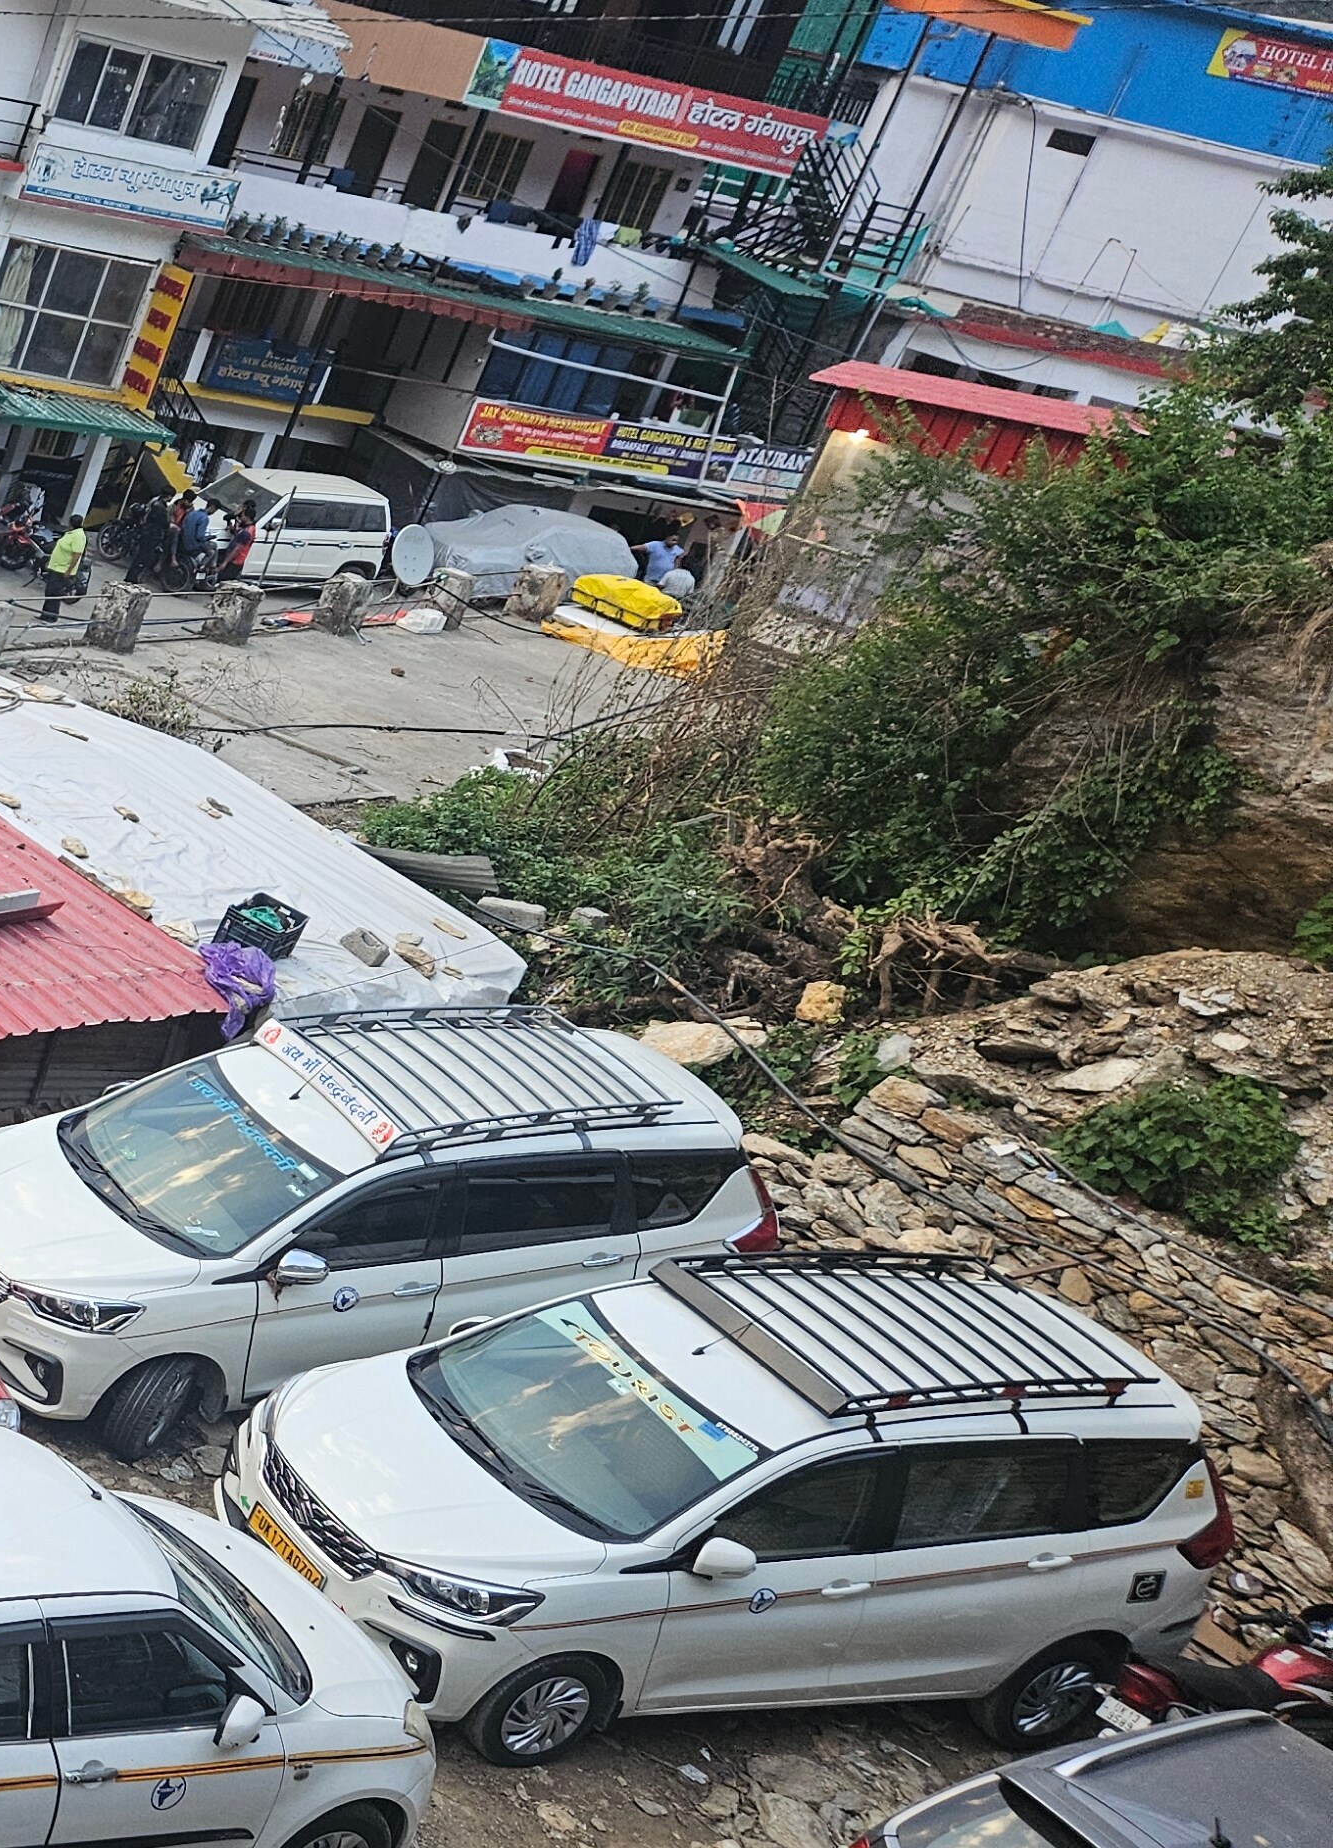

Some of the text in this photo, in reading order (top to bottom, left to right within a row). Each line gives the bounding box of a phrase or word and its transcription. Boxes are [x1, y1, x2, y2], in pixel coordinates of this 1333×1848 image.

[1261, 44, 1319, 70] HOTEL
[512, 59, 682, 120] HOTEL GANGAPUTARA
[687, 97, 742, 132] होटल
[744, 112, 819, 153] गंगापुत्र
[71, 157, 118, 181] होटल
[119, 169, 141, 193] न्यू
[142, 170, 201, 202] गंगापुत्र
[480, 405, 499, 420] JAY
[547, 416, 608, 435] RESTAURANT
[616, 425, 639, 440] HOTEL
[685, 436, 692, 448] &
[282, 1043, 304, 1062] जय
[302, 1056, 322, 1074] माँ
[189, 1080, 217, 1098] जय
[213, 1094, 239, 1113] माँ
[563, 1320, 696, 1434] TOURIST
